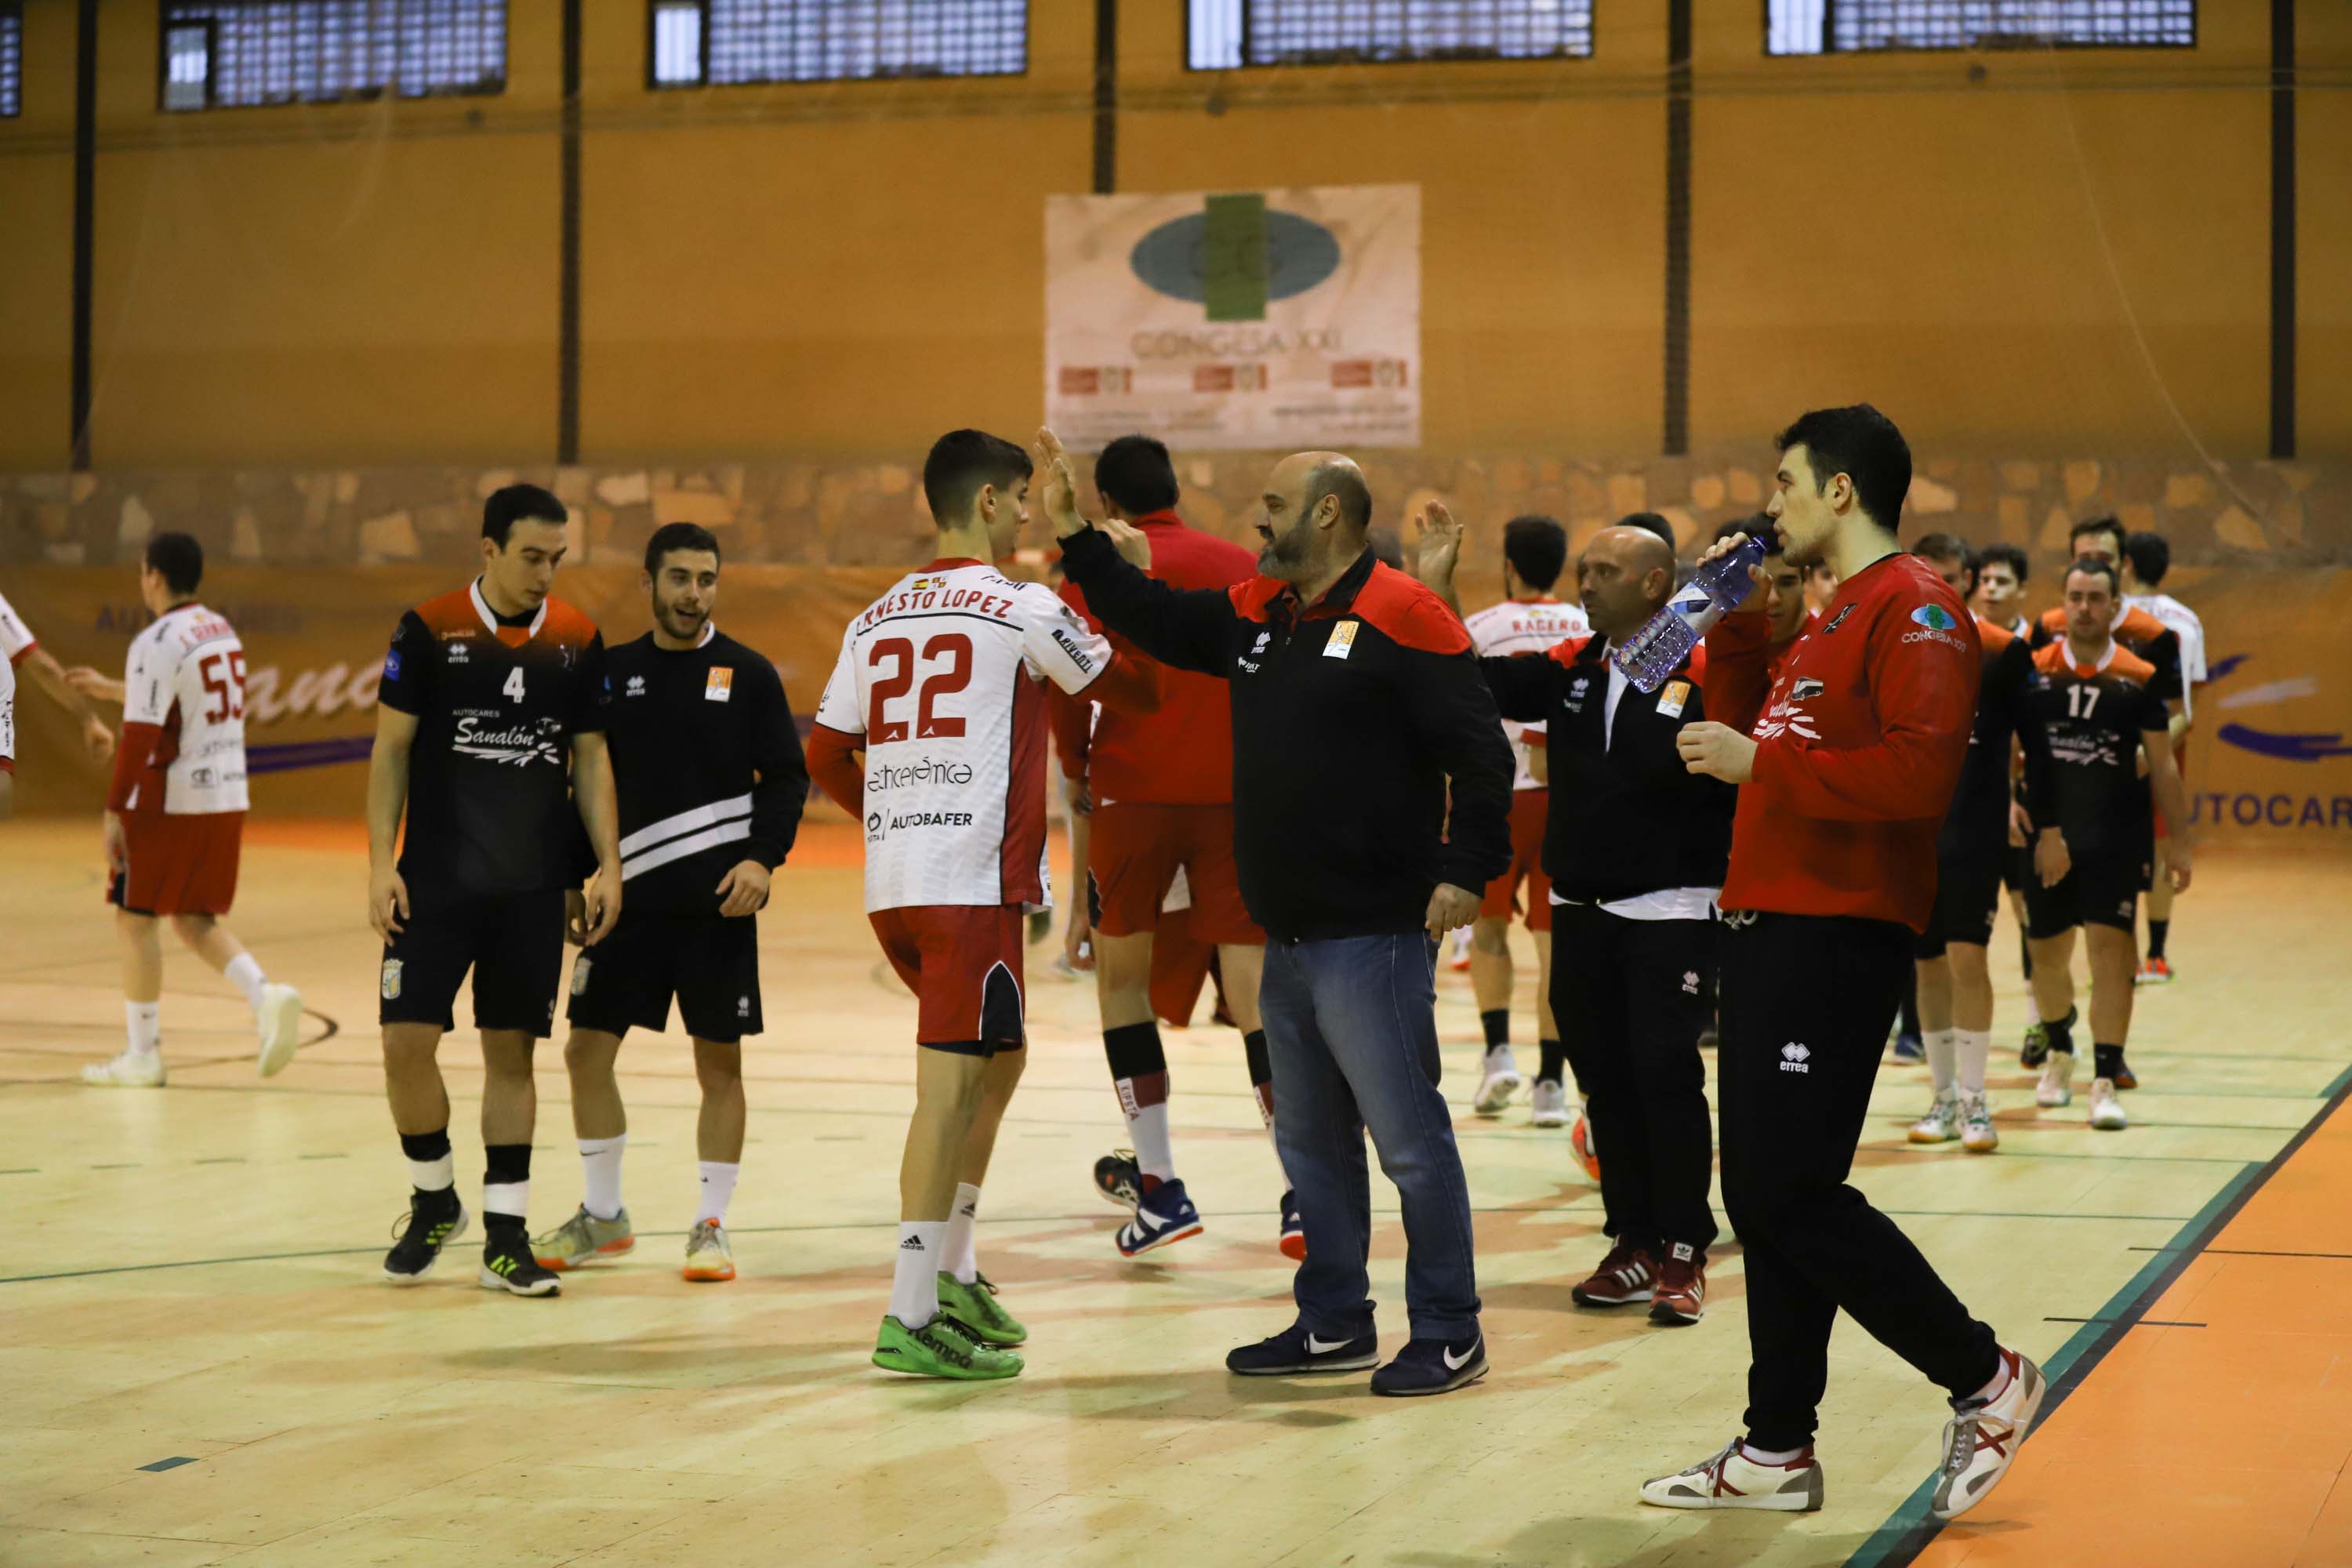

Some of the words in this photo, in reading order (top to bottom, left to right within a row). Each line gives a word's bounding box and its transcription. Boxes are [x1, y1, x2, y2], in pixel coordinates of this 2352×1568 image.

[941, 589, 1013, 618] LOPEZ
[200, 651, 245, 727] 55
[503, 666, 525, 703] 4
[868, 633, 973, 746] 22
[452, 709, 500, 718] AUTOCARES
[2067, 684, 2100, 719] 17
[455, 717, 535, 746] Sanalón
[890, 812, 973, 830] AUTOBAFER
